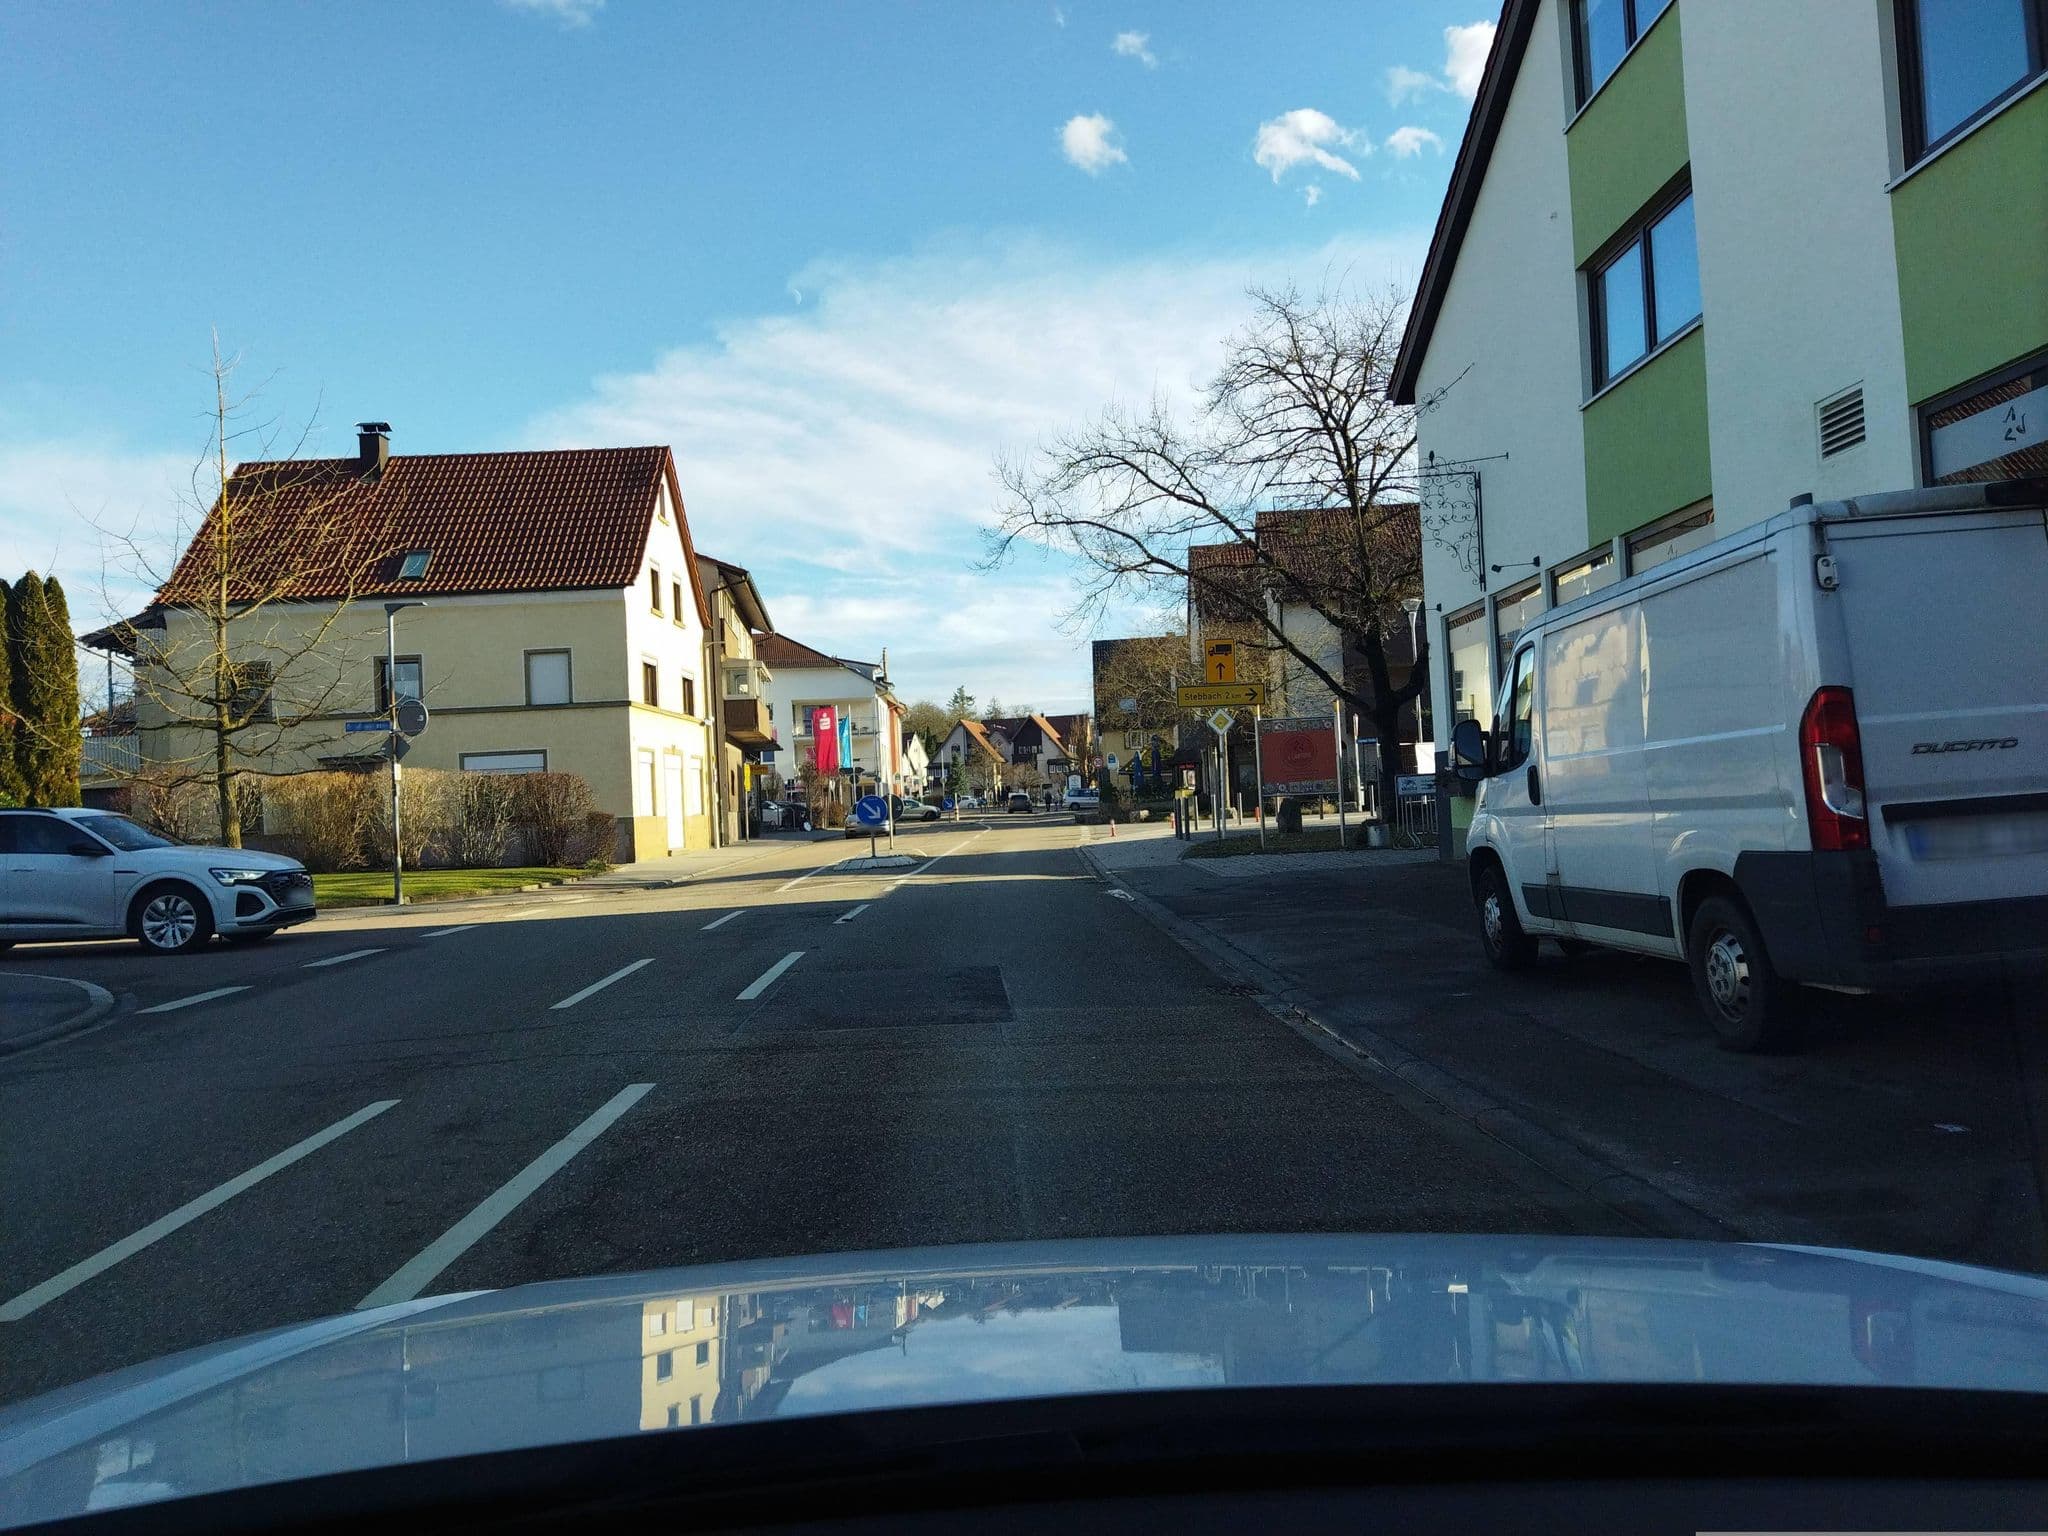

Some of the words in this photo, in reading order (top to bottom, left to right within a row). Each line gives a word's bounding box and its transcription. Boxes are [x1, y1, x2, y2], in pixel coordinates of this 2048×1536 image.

[1184, 691, 1221, 701] Stebbach
[1225, 691, 1230, 699] 2
[1910, 736, 2019, 755] DUCATO
